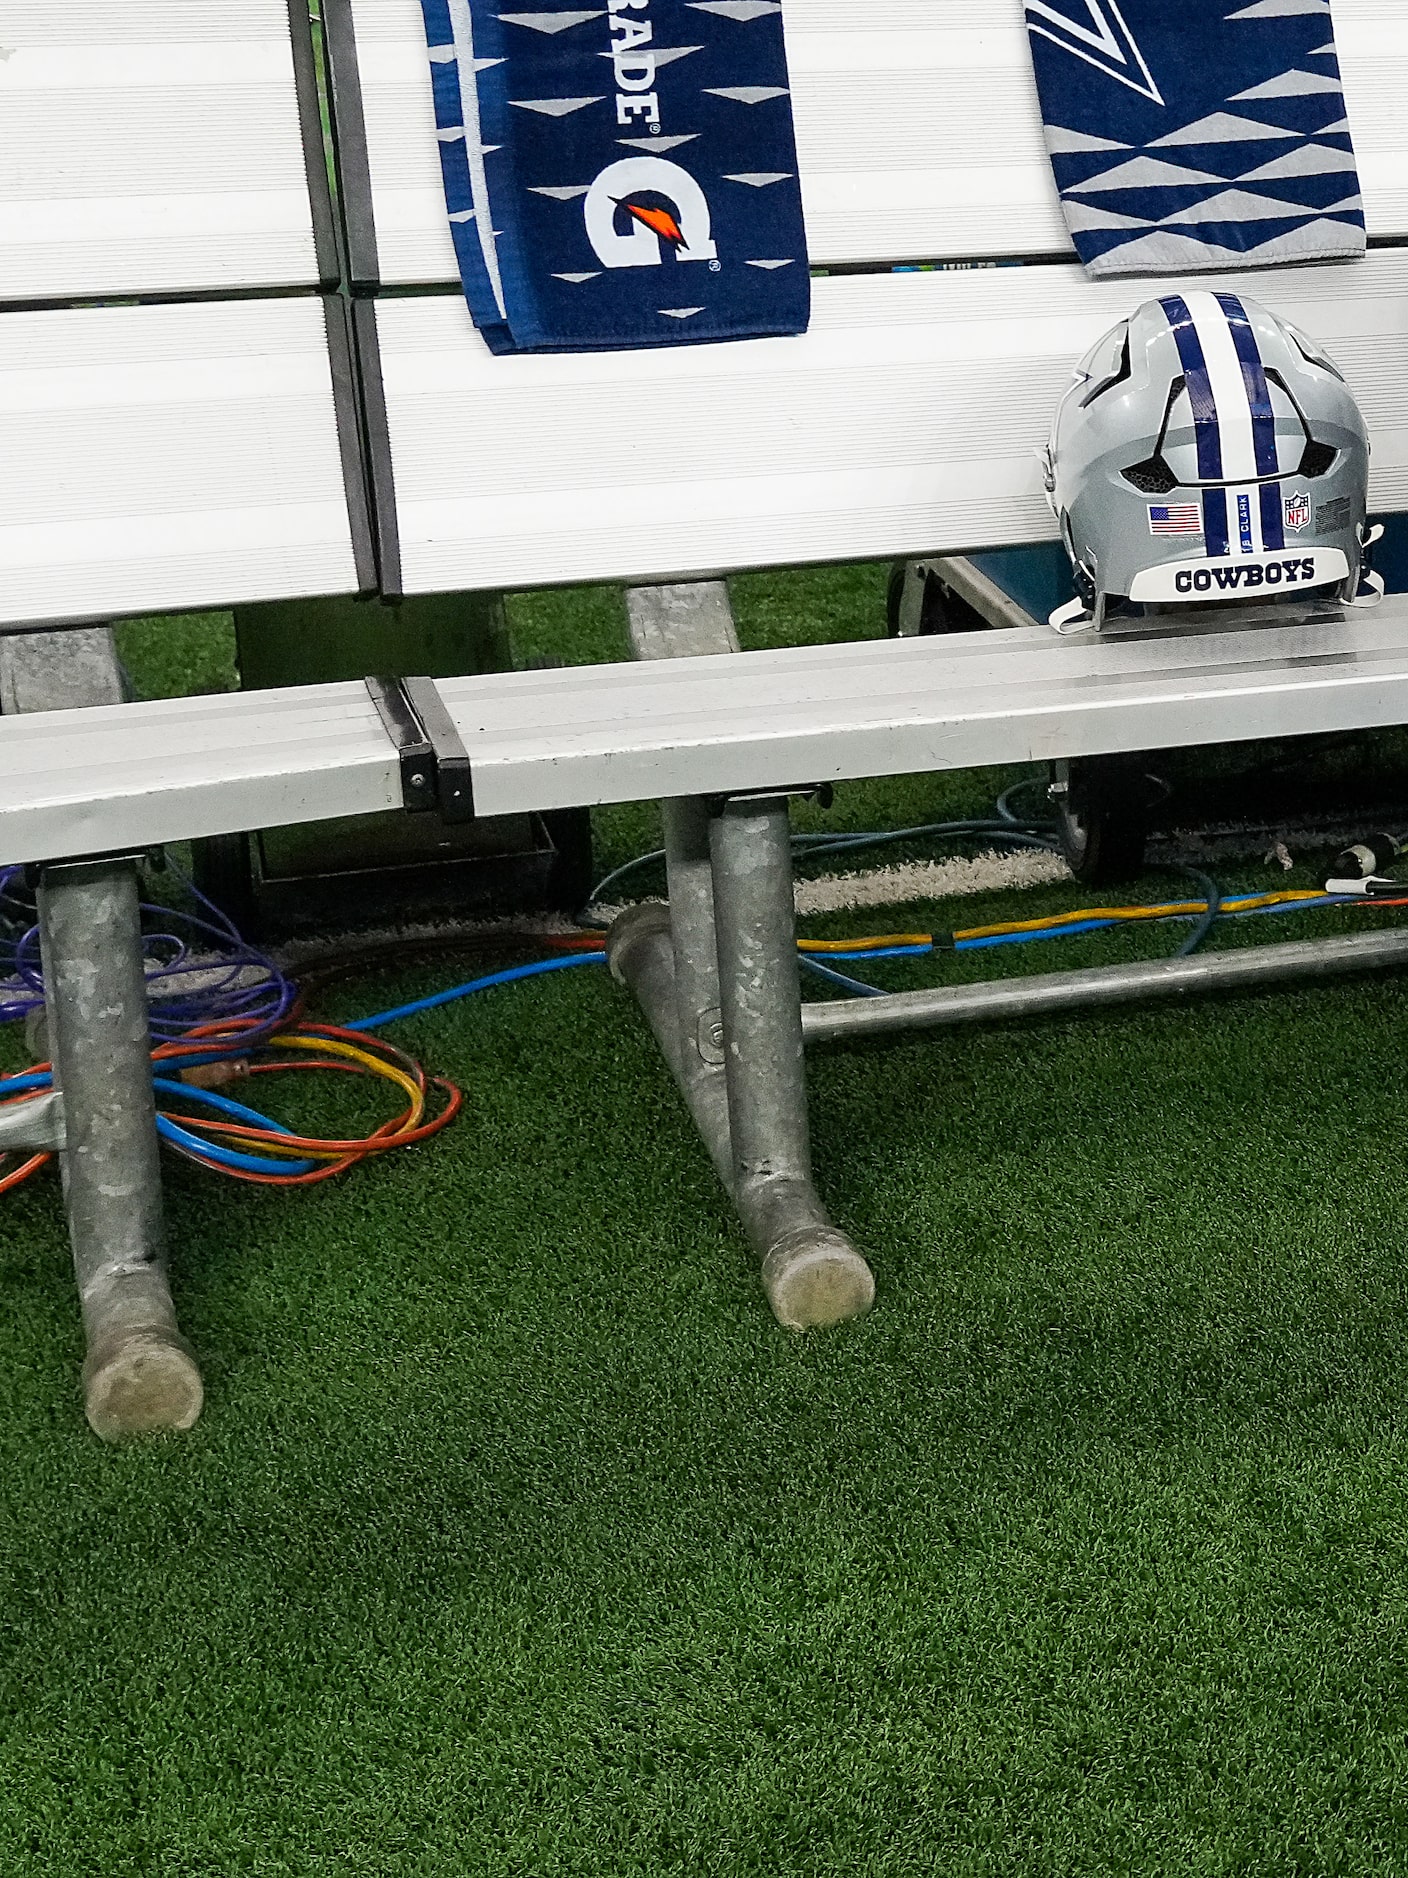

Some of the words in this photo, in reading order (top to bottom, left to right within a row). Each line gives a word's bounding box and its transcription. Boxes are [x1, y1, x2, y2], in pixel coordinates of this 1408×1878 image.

[1239, 496, 1249, 532] CLARK
[1288, 508, 1308, 525] NFL
[1175, 557, 1315, 593] COWBOYS
